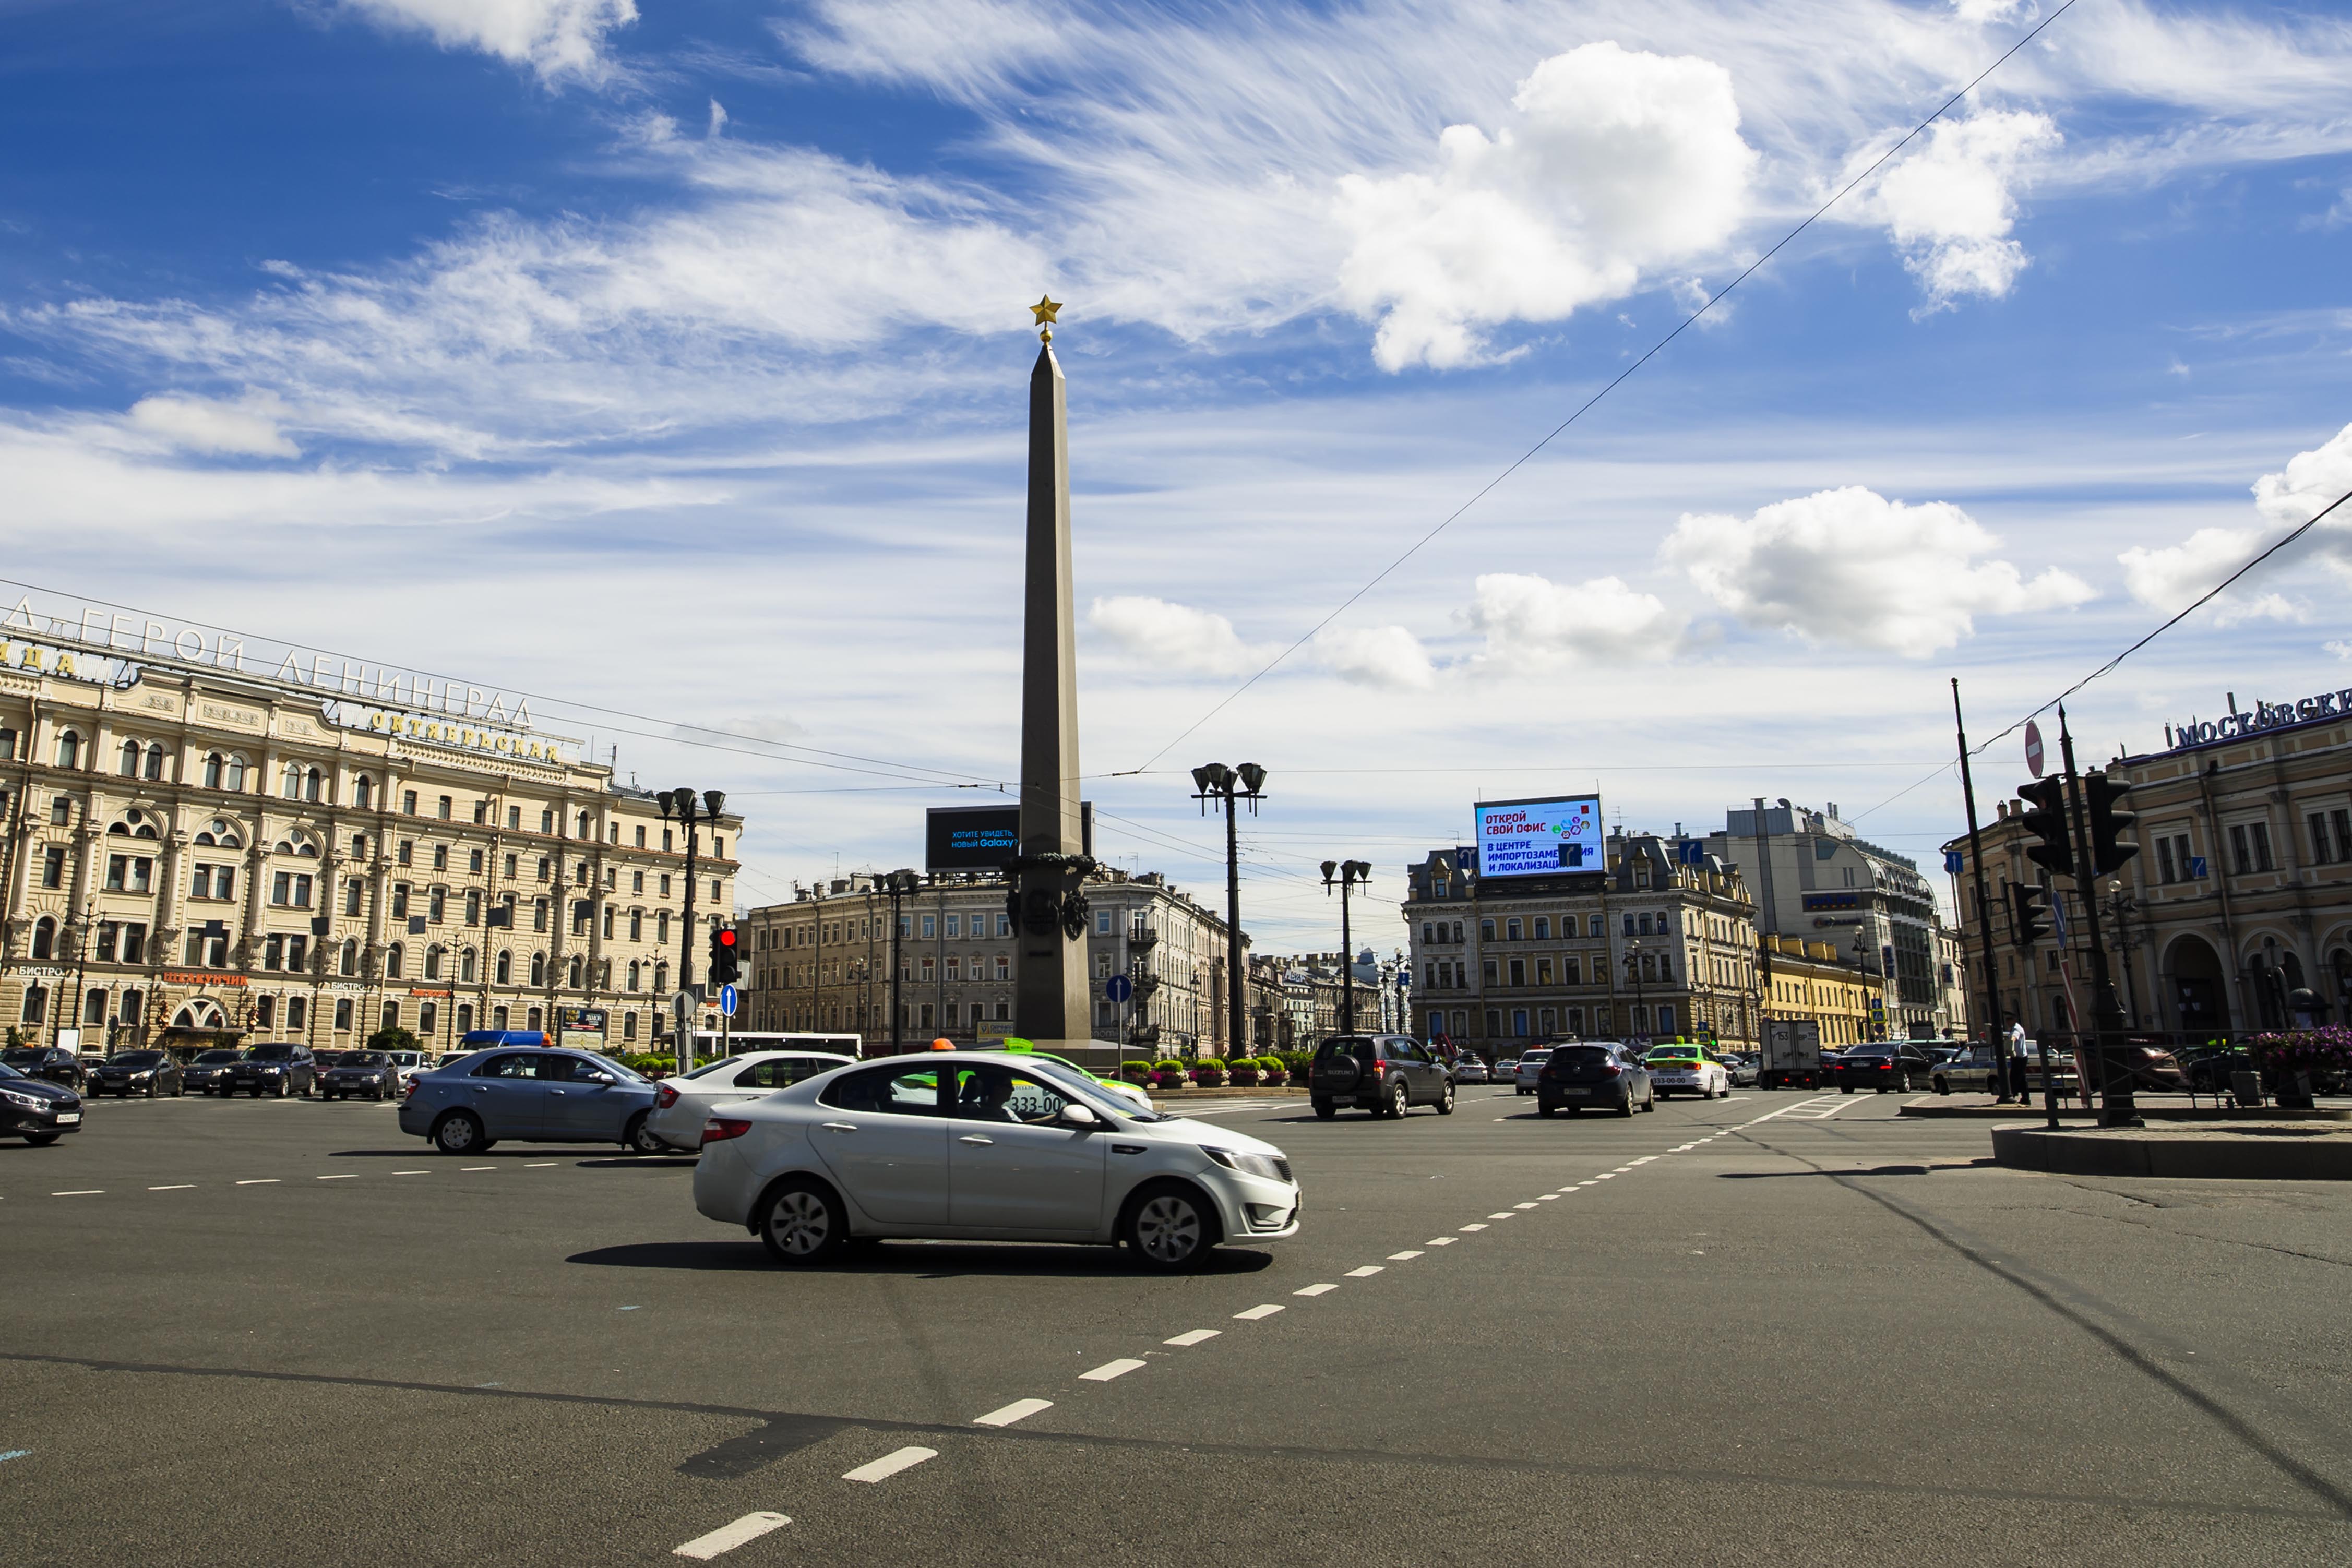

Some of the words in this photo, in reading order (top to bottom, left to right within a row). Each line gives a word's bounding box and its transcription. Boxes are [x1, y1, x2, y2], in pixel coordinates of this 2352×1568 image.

[275, 650, 534, 728] ЛЕНИНГРАД
[372, 712, 558, 761] ОКТЯБРЬСКАЯ
[1486, 810, 1526, 824] ОТКРОЙ
[980, 830, 1014, 838] УВИДЕТЬ,
[1486, 821, 1513, 835] СВОЙ
[1516, 822, 1546, 833] ОФИС
[951, 840, 978, 848] НОВЫЙ
[1488, 843, 1494, 852] В
[1496, 841, 1532, 852] ЦЕНТРЕ
[1488, 847, 1594, 861] ИМПОРТОЗАМЕИЯ
[1488, 864, 1495, 872] И
[1497, 860, 1568, 872] ЛОКАЛИЗАЦ
[19, 966, 63, 976] БИСТРО
[163, 972, 248, 986] ЩЕЛКУНЧИК
[331, 982, 364, 991] БИСТРО
[1011, 1097, 1061, 1112] 333-00
